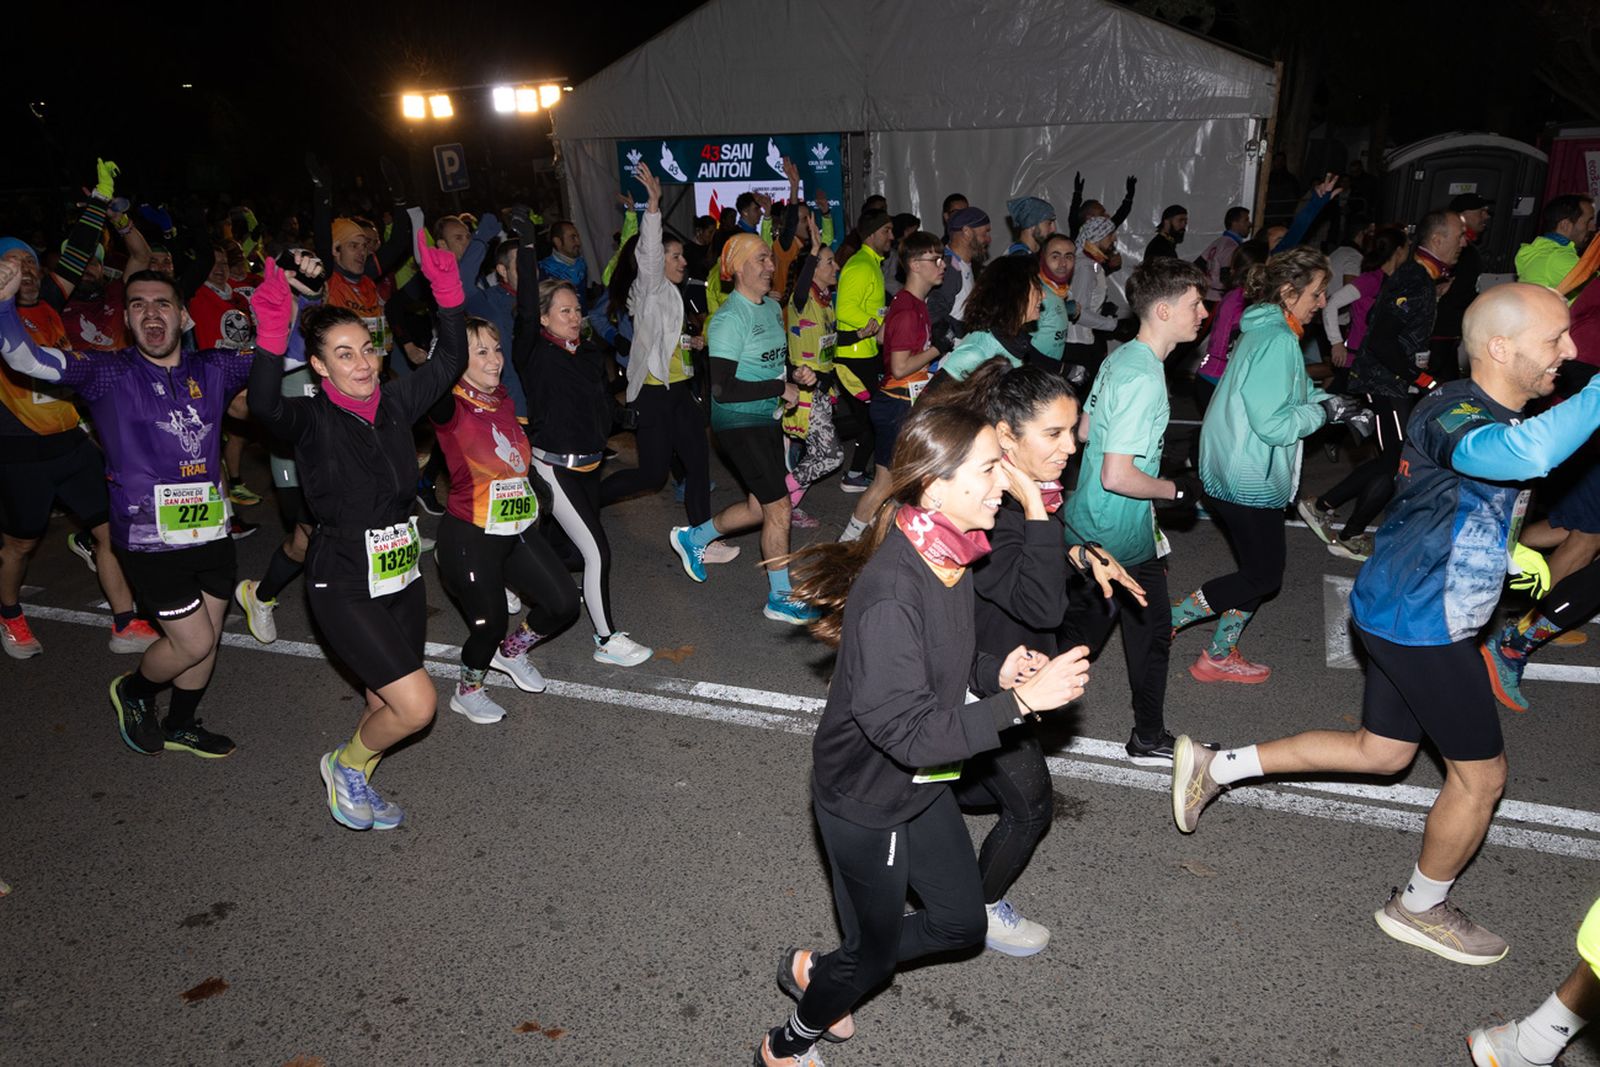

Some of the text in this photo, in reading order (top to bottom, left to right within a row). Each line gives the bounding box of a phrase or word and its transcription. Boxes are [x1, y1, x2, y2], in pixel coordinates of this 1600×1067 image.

[701, 143, 754, 161] 43 SAN
[442, 151, 460, 175] P
[668, 163, 679, 175] 43
[697, 157, 752, 178] ANTÓN
[180, 464, 207, 478] TRAIL
[178, 504, 209, 523] 272
[500, 497, 531, 516] 2796
[374, 543, 389, 553] SAN
